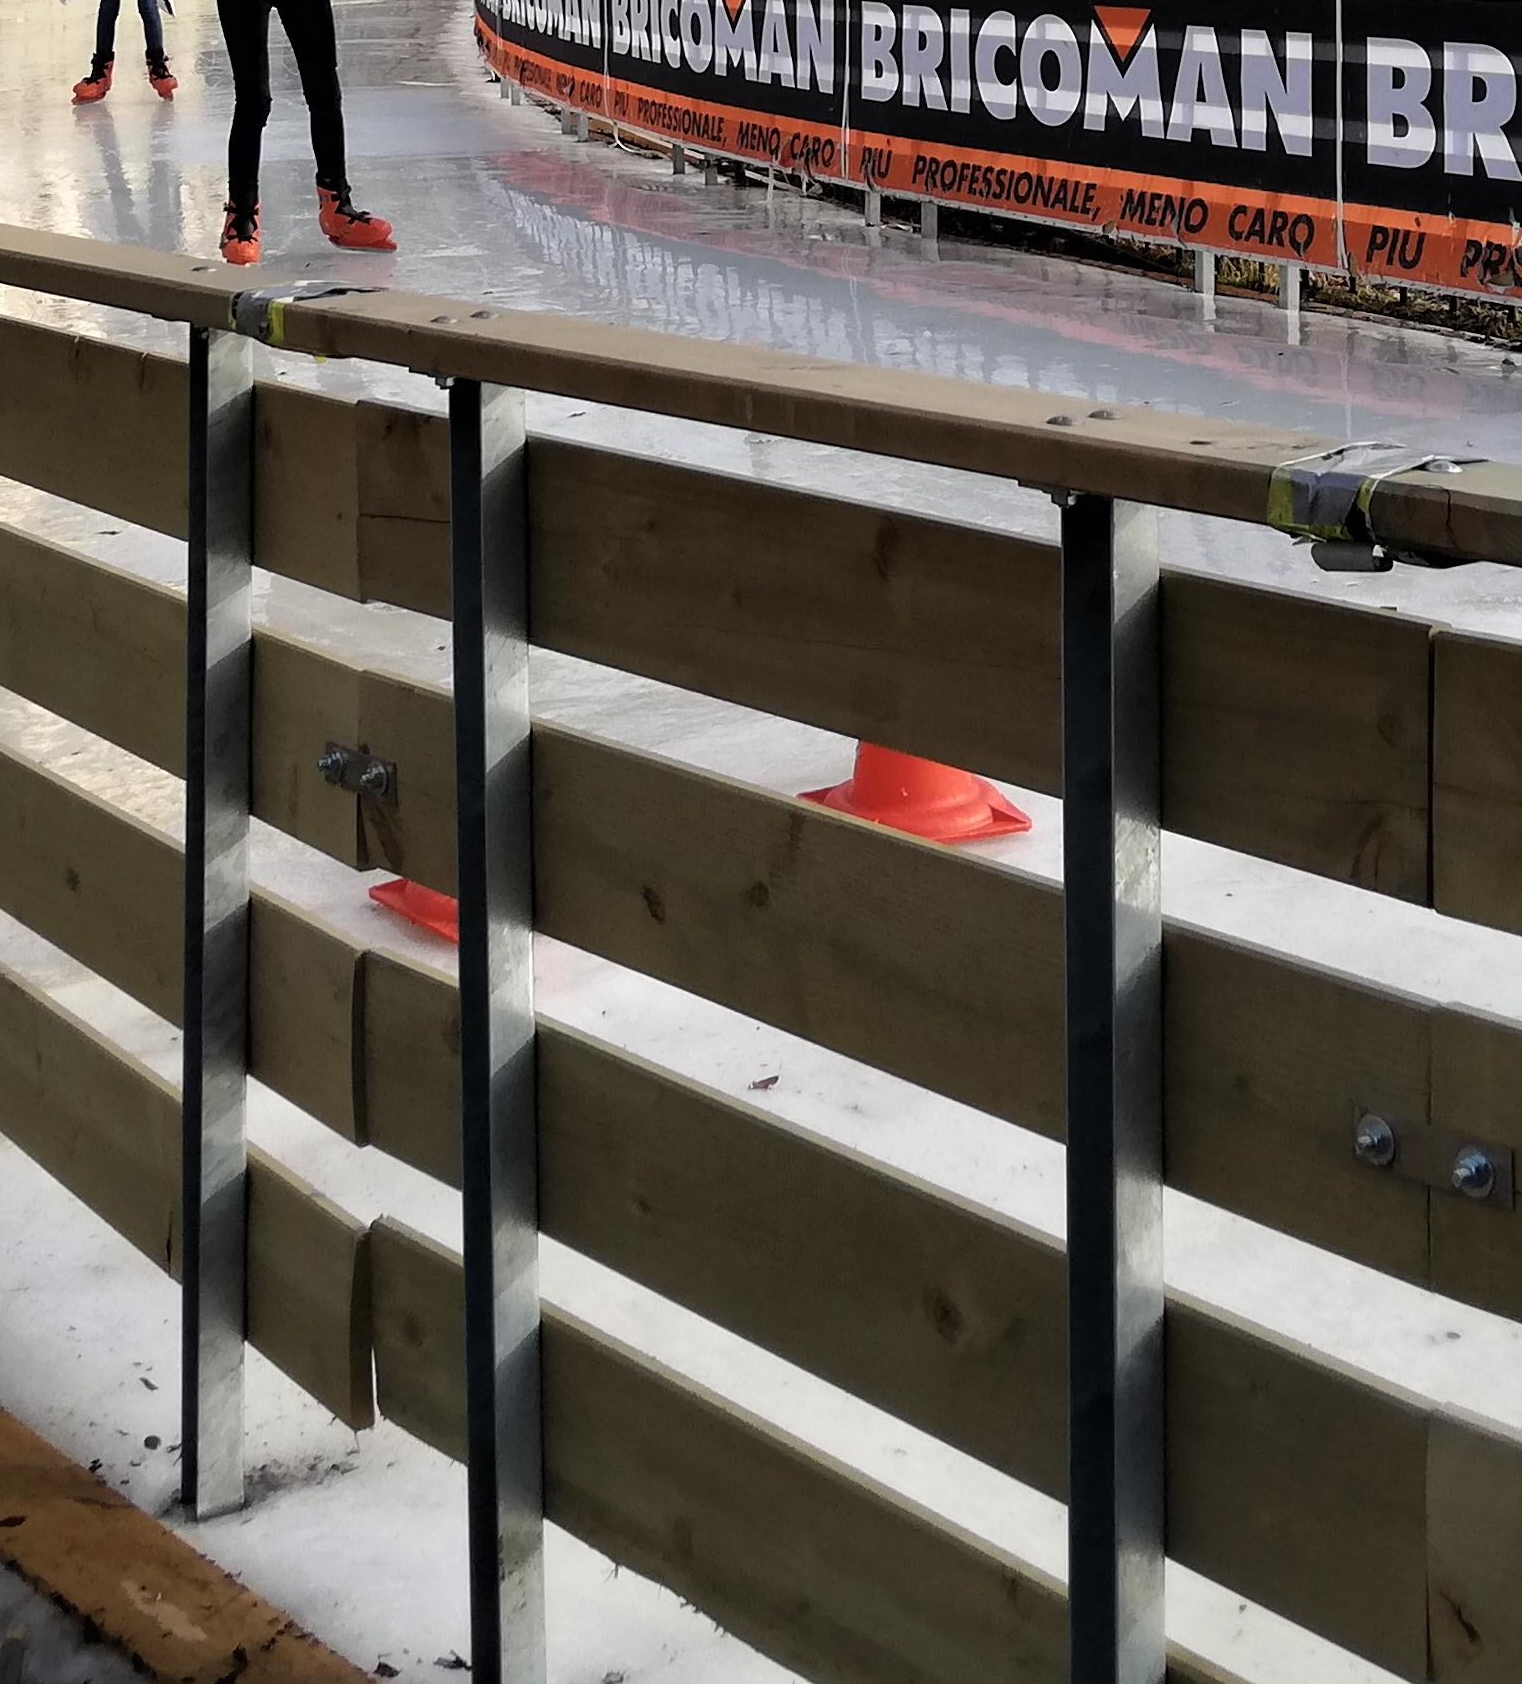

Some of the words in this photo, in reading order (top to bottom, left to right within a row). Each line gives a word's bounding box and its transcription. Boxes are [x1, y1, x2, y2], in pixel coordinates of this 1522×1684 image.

[579, 80, 603, 109] CARO
[861, 1, 1313, 157] BRICOMAN
[637, 97, 727, 148] PROFESSIONALE,
[737, 121, 781, 157] MENO
[790, 132, 835, 167] CARO
[911, 154, 1102, 222] PROFESSIONALE,
[1119, 188, 1209, 235] MENO
[1228, 204, 1314, 257] CARO
[1365, 217, 1426, 270] PIÙ
